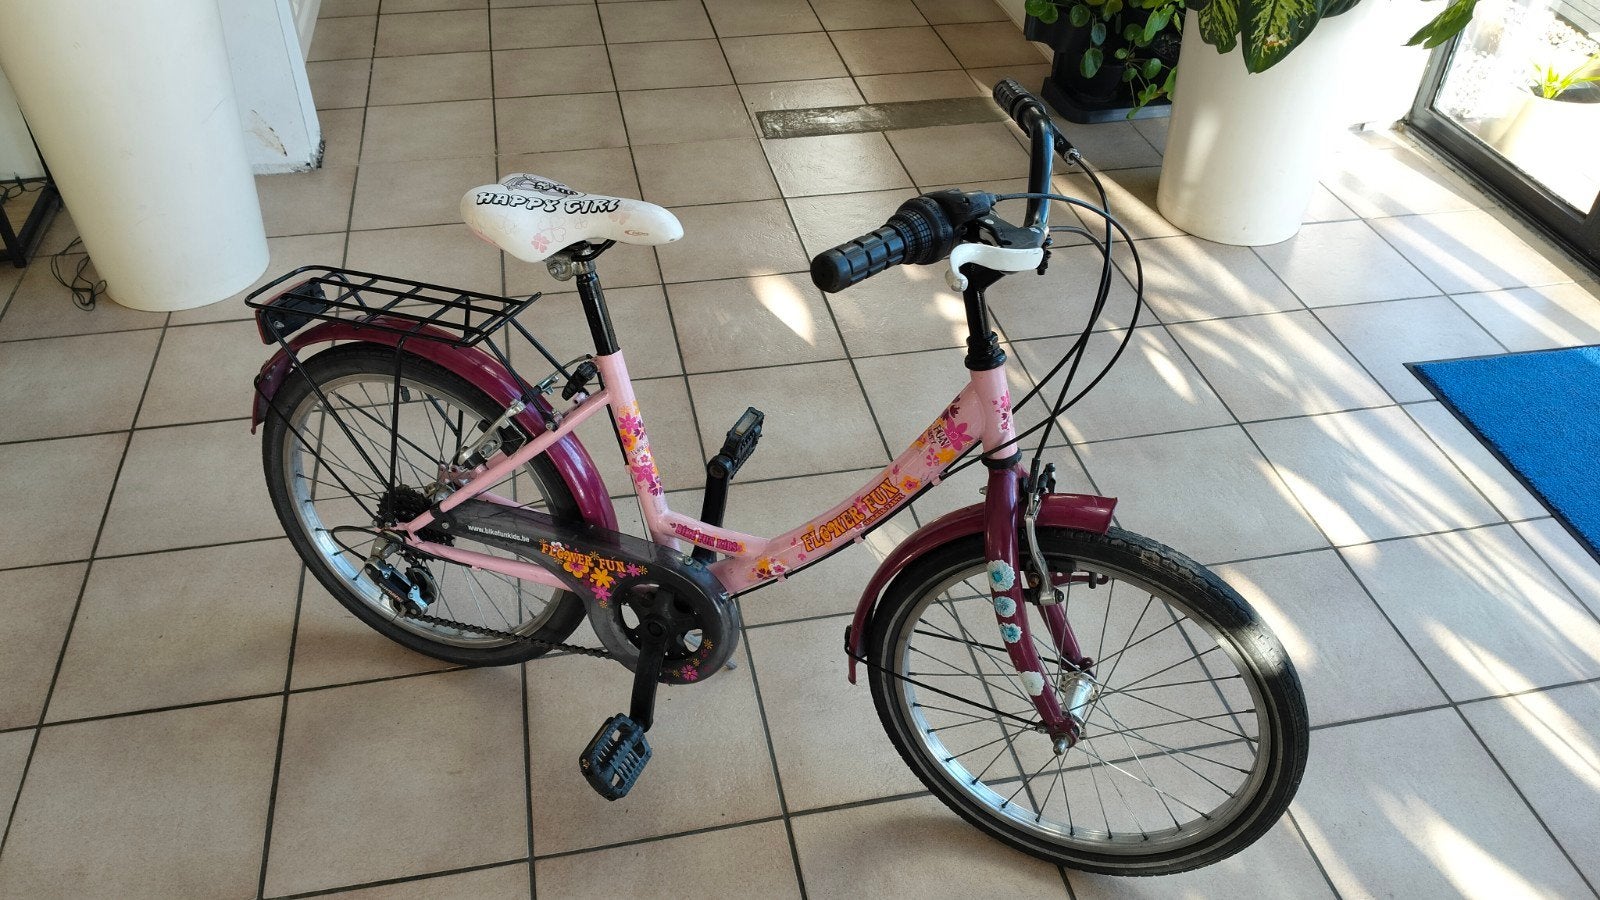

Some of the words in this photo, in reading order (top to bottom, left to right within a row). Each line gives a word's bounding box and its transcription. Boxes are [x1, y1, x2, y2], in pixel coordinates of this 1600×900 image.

[476, 192, 561, 213] HAPPY
[564, 199, 620, 214] GIRL
[801, 506, 866, 552] FLOWER
[861, 477, 900, 513] FUN
[541, 543, 593, 567] FLOWER
[599, 558, 626, 573] FUN
